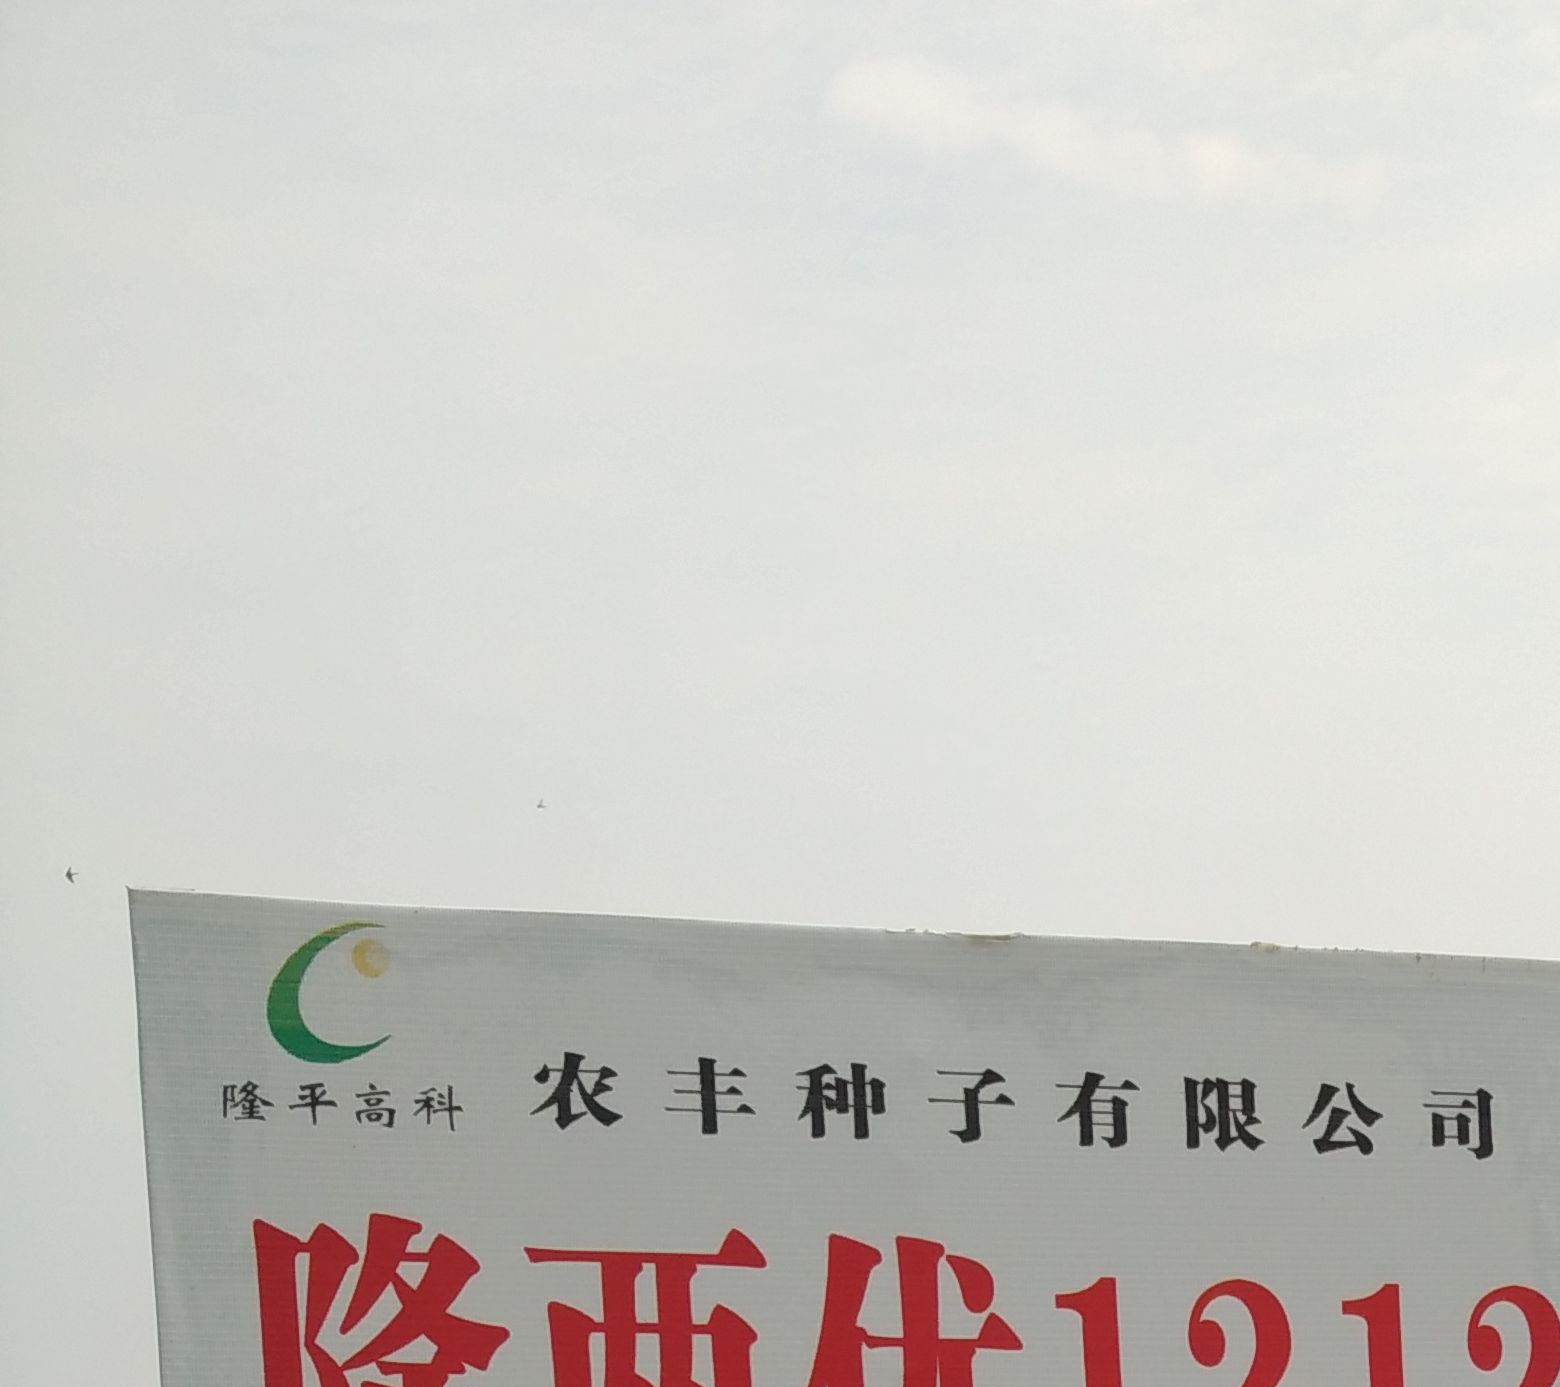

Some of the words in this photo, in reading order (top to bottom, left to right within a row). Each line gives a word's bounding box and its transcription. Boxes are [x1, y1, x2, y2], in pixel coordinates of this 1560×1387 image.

[220, 1079, 464, 1131] 隆平高科
[529, 1050, 1497, 1161] 农丰种子有限公司
